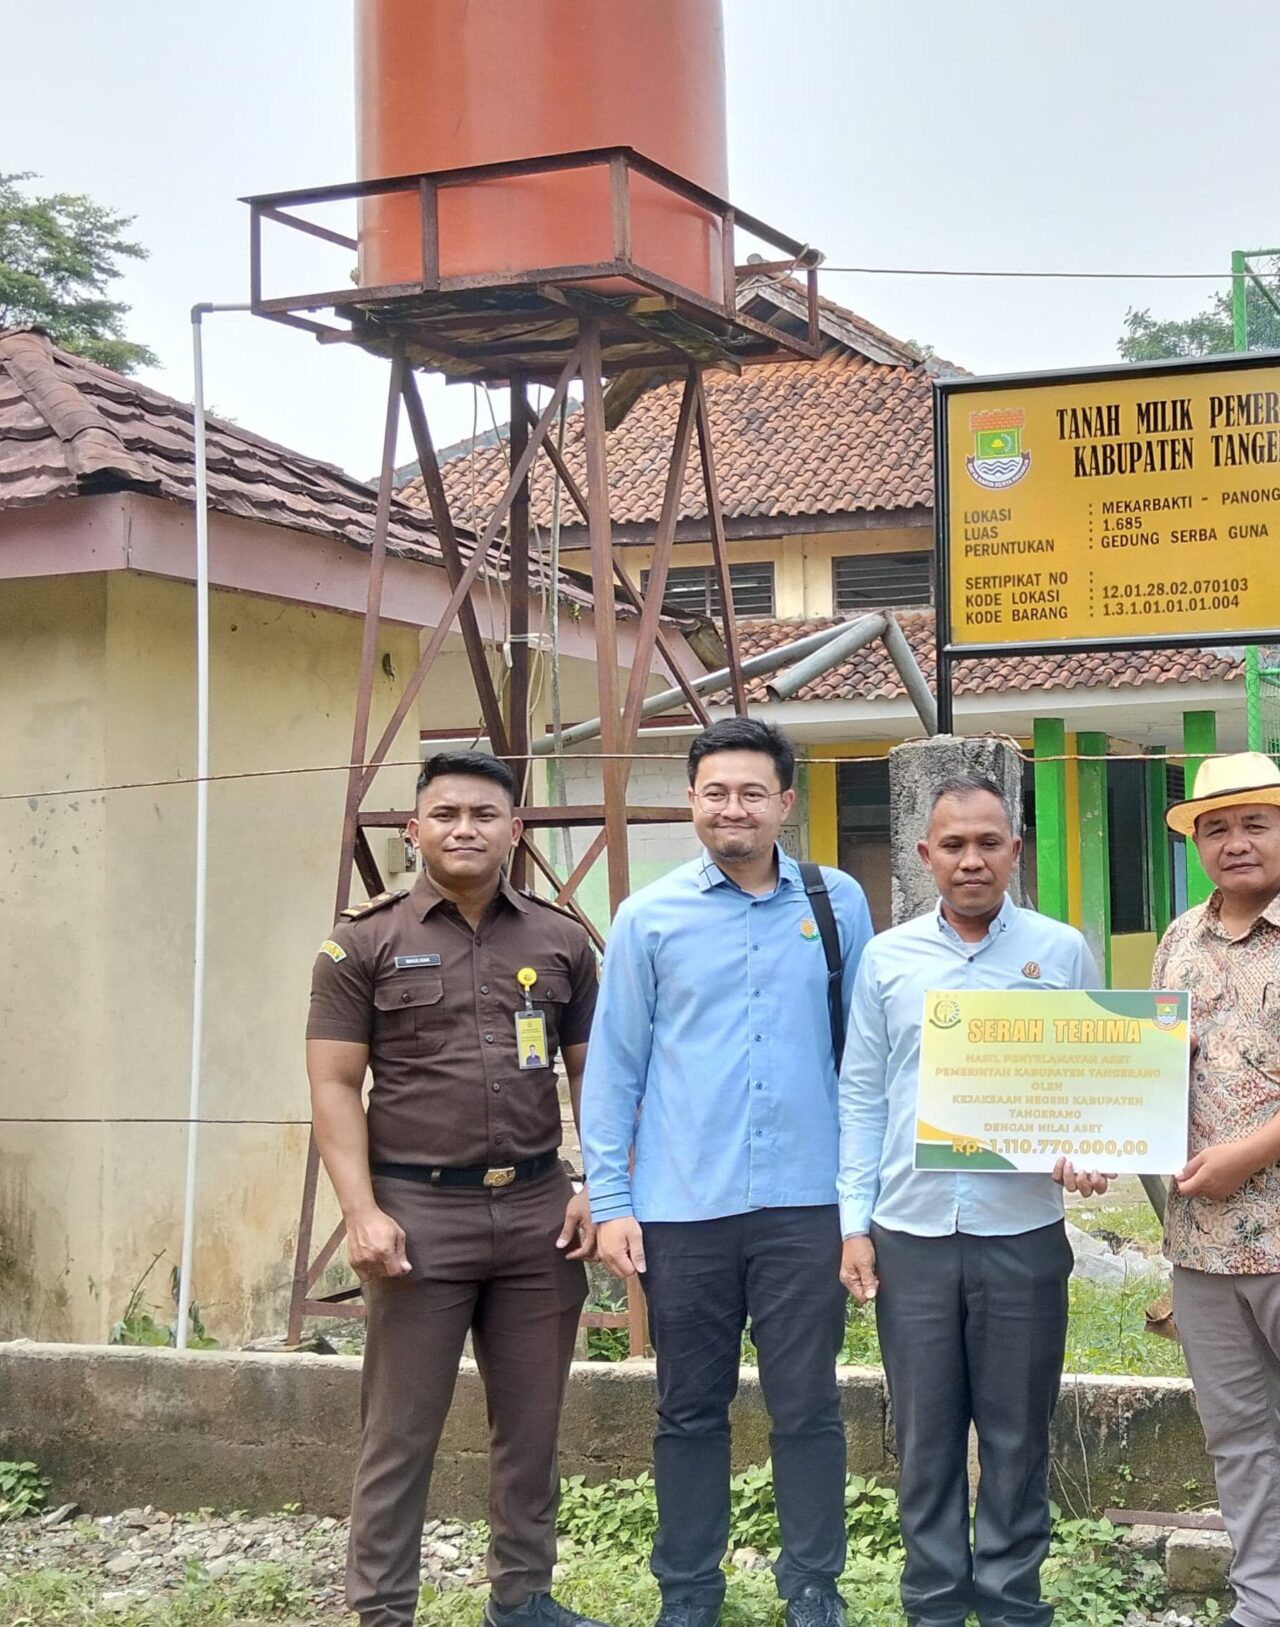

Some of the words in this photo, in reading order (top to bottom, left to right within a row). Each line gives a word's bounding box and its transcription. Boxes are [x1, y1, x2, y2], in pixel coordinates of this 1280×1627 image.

[1056, 404, 1120, 440] TANAH
[1136, 398, 1193, 435] MILIK
[1073, 437, 1194, 477] KABUPATEN
[964, 508, 1012, 524] LOKASI
[1102, 495, 1193, 515] MEKARBAKTI
[964, 526, 999, 541] LUAS
[1103, 516, 1143, 532] 1.685
[965, 538, 1055, 557] PERUNTUKAN
[1101, 532, 1160, 549] GEDUNG
[1170, 528, 1218, 544] SERBA
[1228, 523, 1269, 540] GUNA
[965, 573, 1042, 591] SERTIPIKAT
[1049, 571, 1068, 585] NO
[966, 593, 1002, 608] KODE
[1012, 589, 1060, 605] LOKASI
[1102, 577, 1249, 599] 12.01.28.02.070103
[966, 610, 1002, 625] KODE
[1012, 606, 1068, 622] BARANG
[1103, 594, 1240, 617] 1.3.1.01.01.01.004
[968, 1019, 1044, 1043] SERAH
[1053, 1019, 1142, 1043] TERIMA
[966, 1054, 1000, 1063] HASIL
[935, 1067, 1011, 1077] PEMERINTAH
[1014, 1067, 1085, 1077] KABUPATEN
[1088, 1068, 1161, 1078] TANGERANG
[1031, 1082, 1063, 1091] OLEH
[952, 1095, 1022, 1104] KEJAKSAAN
[1025, 1095, 1069, 1105] NEGERI
[1072, 1096, 1144, 1106] KABUPATEN
[1009, 1109, 1082, 1119] TANGERANG
[984, 1123, 1034, 1132] DENGAN
[1038, 1123, 1069, 1132] NILAI
[1072, 1124, 1103, 1133] ASET
[952, 1137, 983, 1157] Rp.
[990, 1138, 1148, 1158] 1.110.770.000,00
